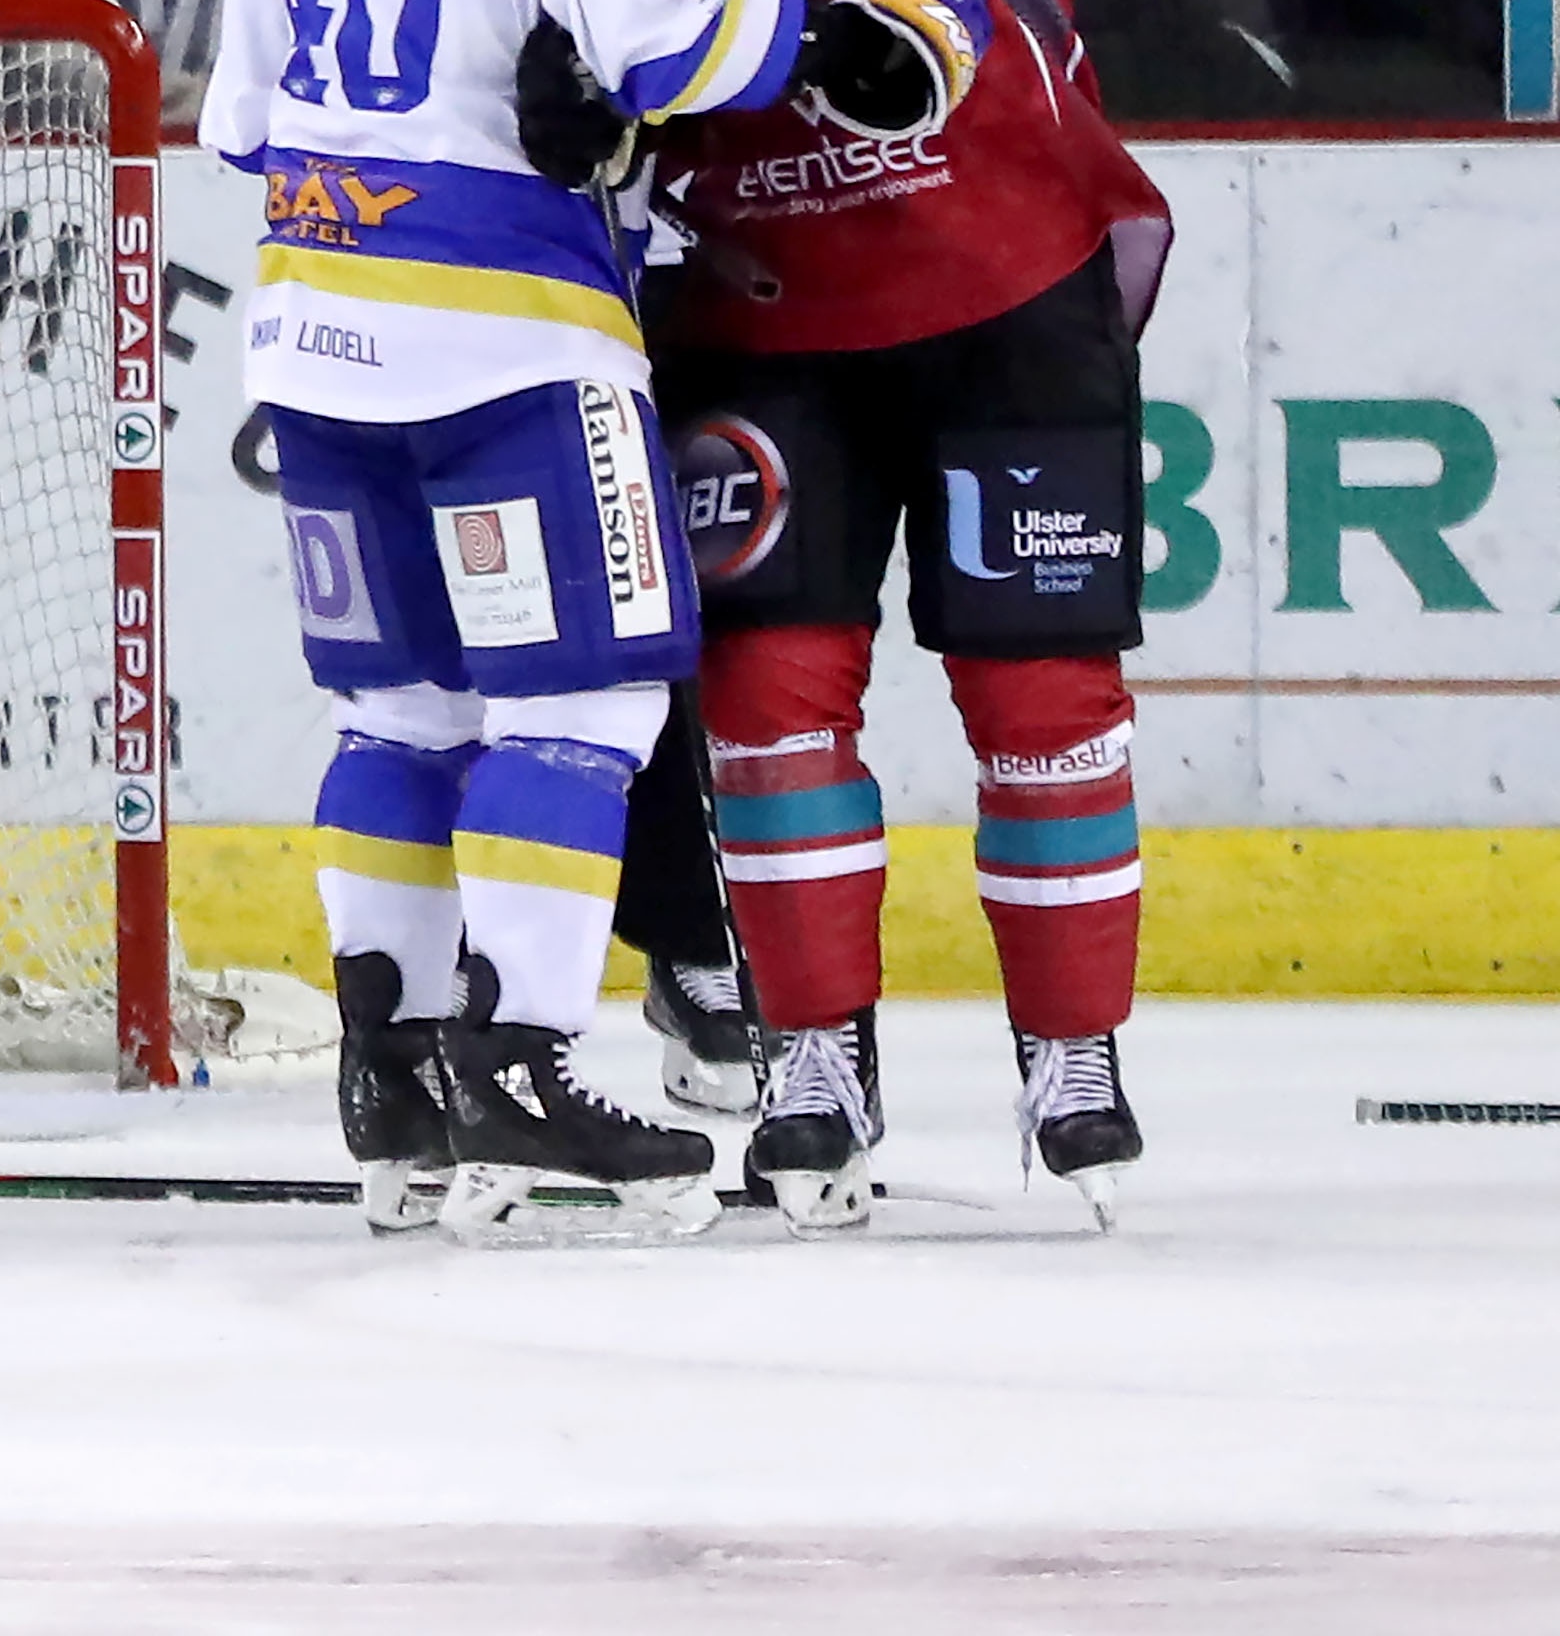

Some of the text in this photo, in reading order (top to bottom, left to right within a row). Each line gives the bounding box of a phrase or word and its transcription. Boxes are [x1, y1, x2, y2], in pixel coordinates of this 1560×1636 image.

[266, 172, 421, 228] BAY
[116, 215, 150, 400] SPAR
[296, 320, 384, 368] LIDDELL
[582, 383, 634, 605] damson
[686, 471, 760, 532] BC
[1012, 510, 1086, 534] Ulster
[1013, 529, 1123, 559] University
[116, 588, 147, 771] SPAR
